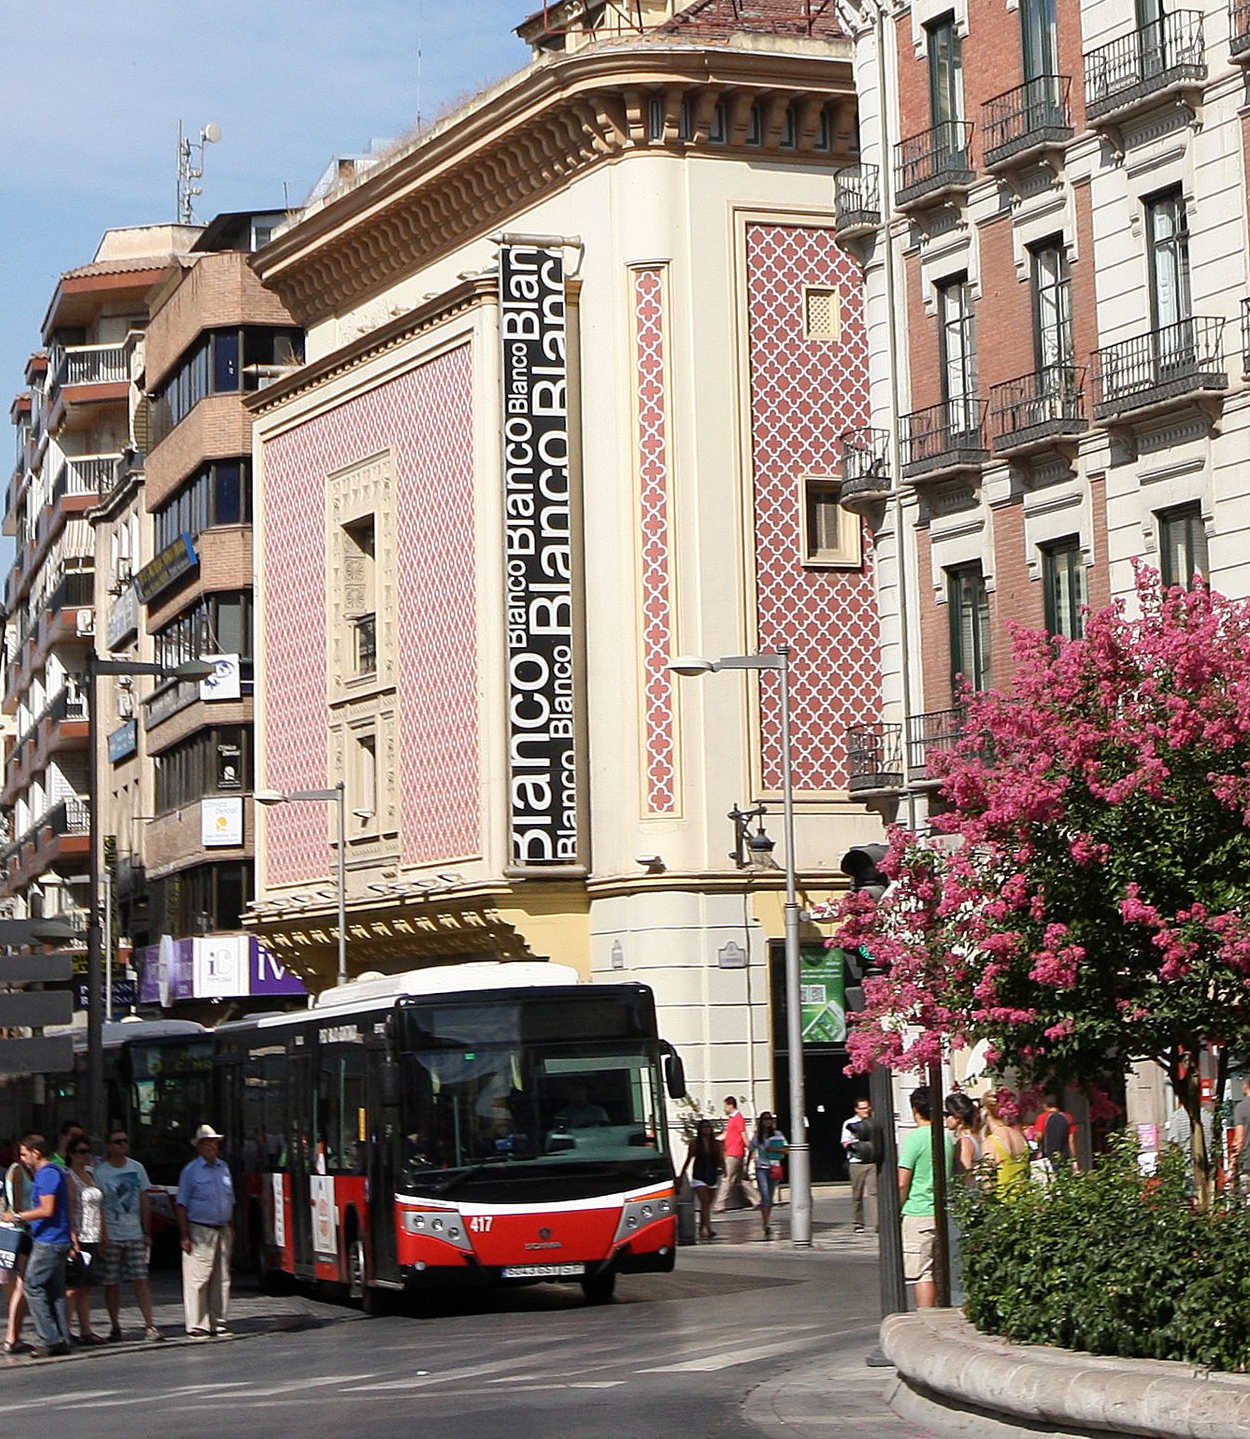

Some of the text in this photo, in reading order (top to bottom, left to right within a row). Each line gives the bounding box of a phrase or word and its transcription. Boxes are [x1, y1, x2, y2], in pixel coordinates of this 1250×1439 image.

[508, 342, 528, 414] Blanco
[505, 417, 536, 556] Blanco
[529, 431, 573, 636] Blanco
[507, 560, 527, 648] Blanco
[550, 645, 574, 739] Blanco
[557, 750, 578, 858] Blanco
[470, 1216, 493, 1232] 417
